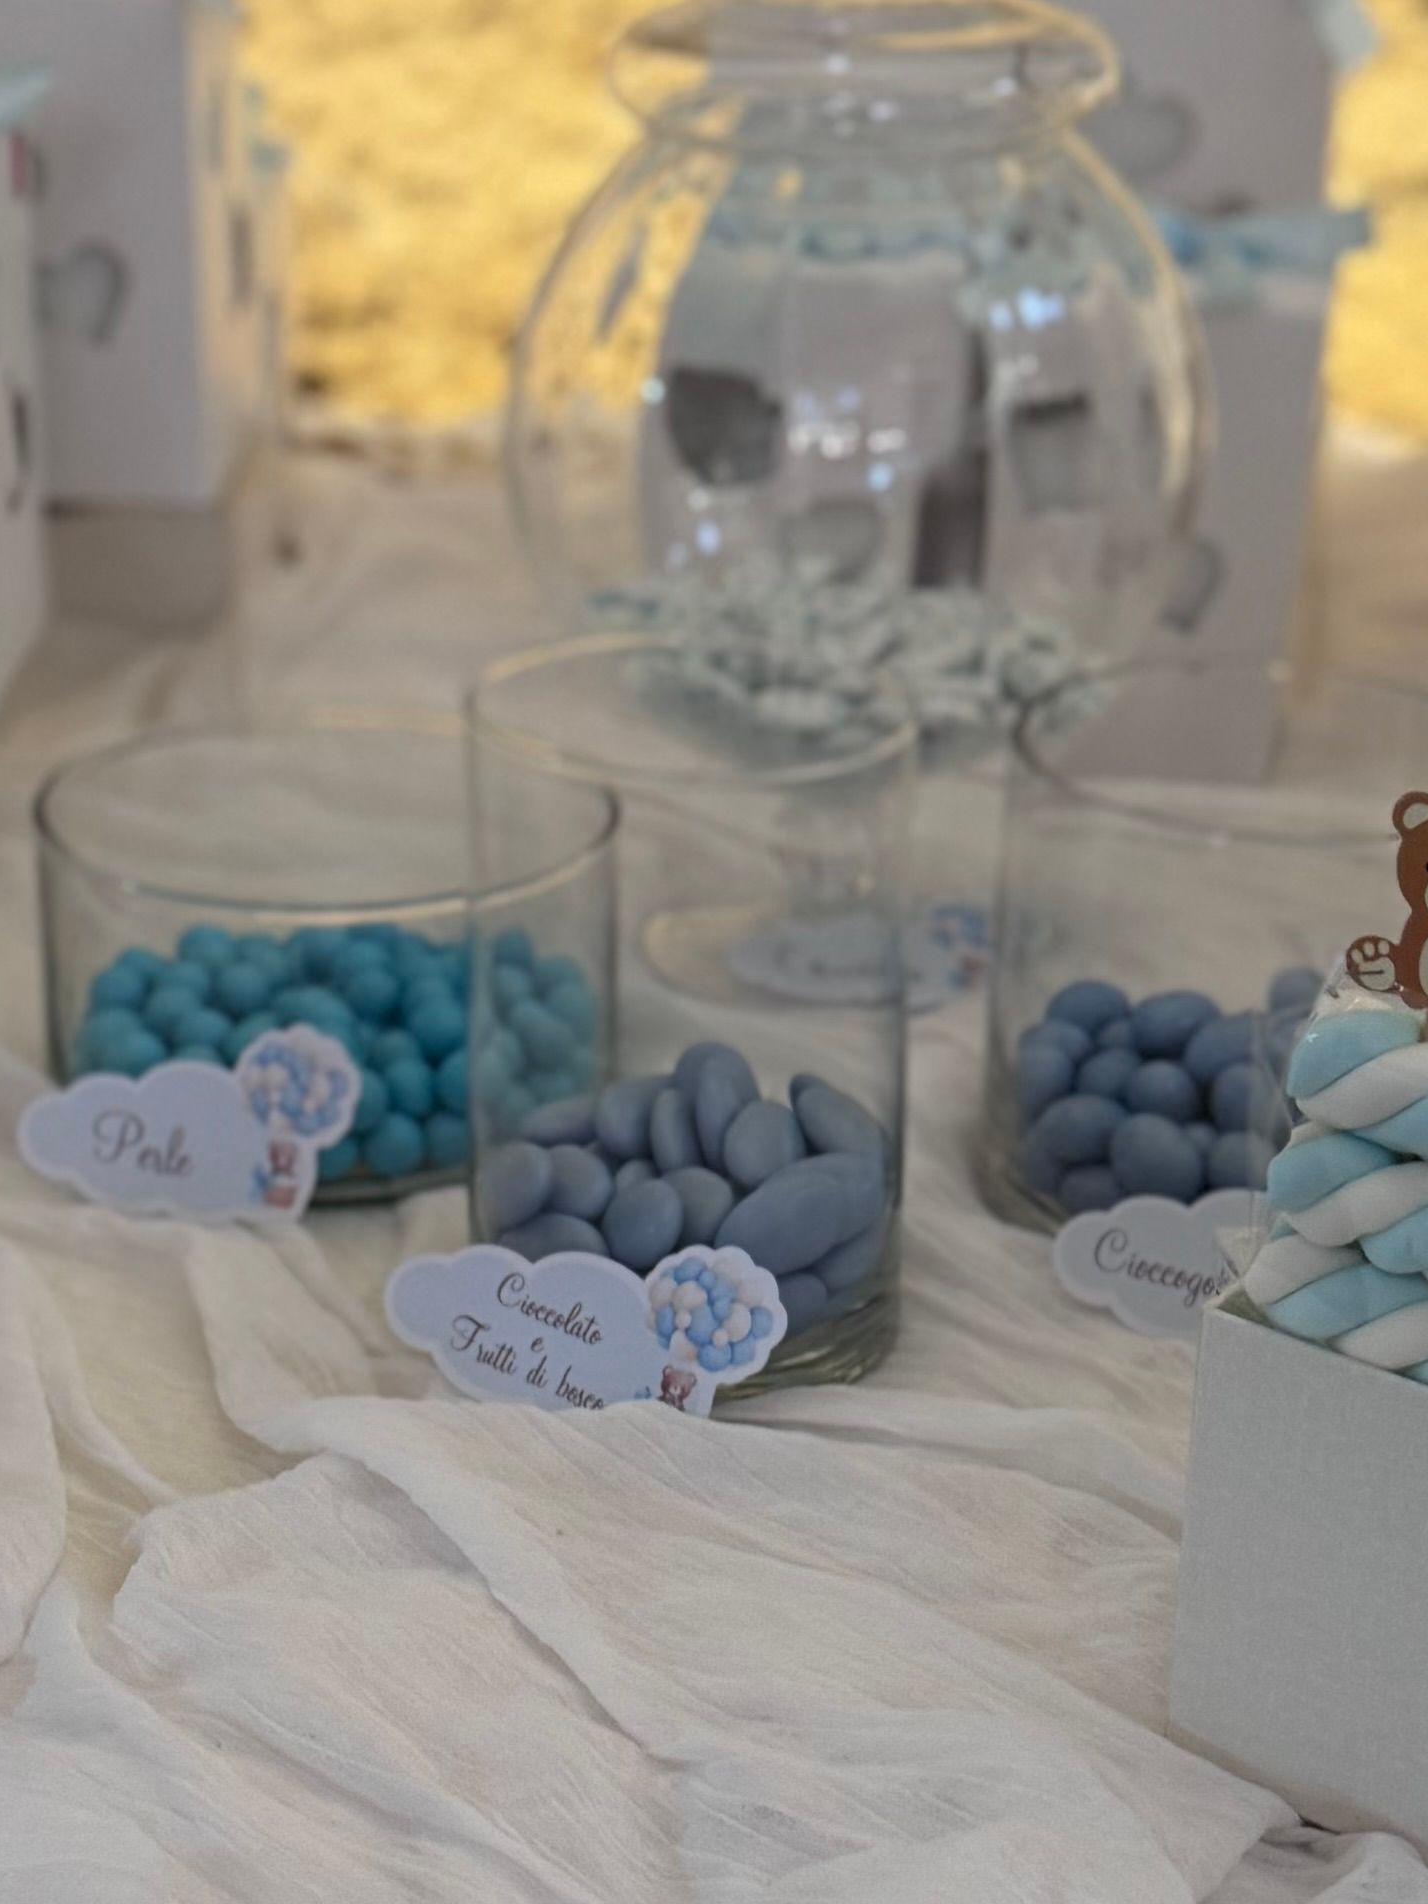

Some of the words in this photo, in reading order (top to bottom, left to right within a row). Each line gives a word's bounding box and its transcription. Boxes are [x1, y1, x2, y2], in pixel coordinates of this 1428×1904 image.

[92, 1108, 196, 1179] Perle
[496, 1272, 604, 1346] Cioccolato
[530, 1336, 545, 1352] e
[449, 1313, 518, 1375] Frutti
[525, 1354, 548, 1389] di
[555, 1364, 605, 1411] bosco
